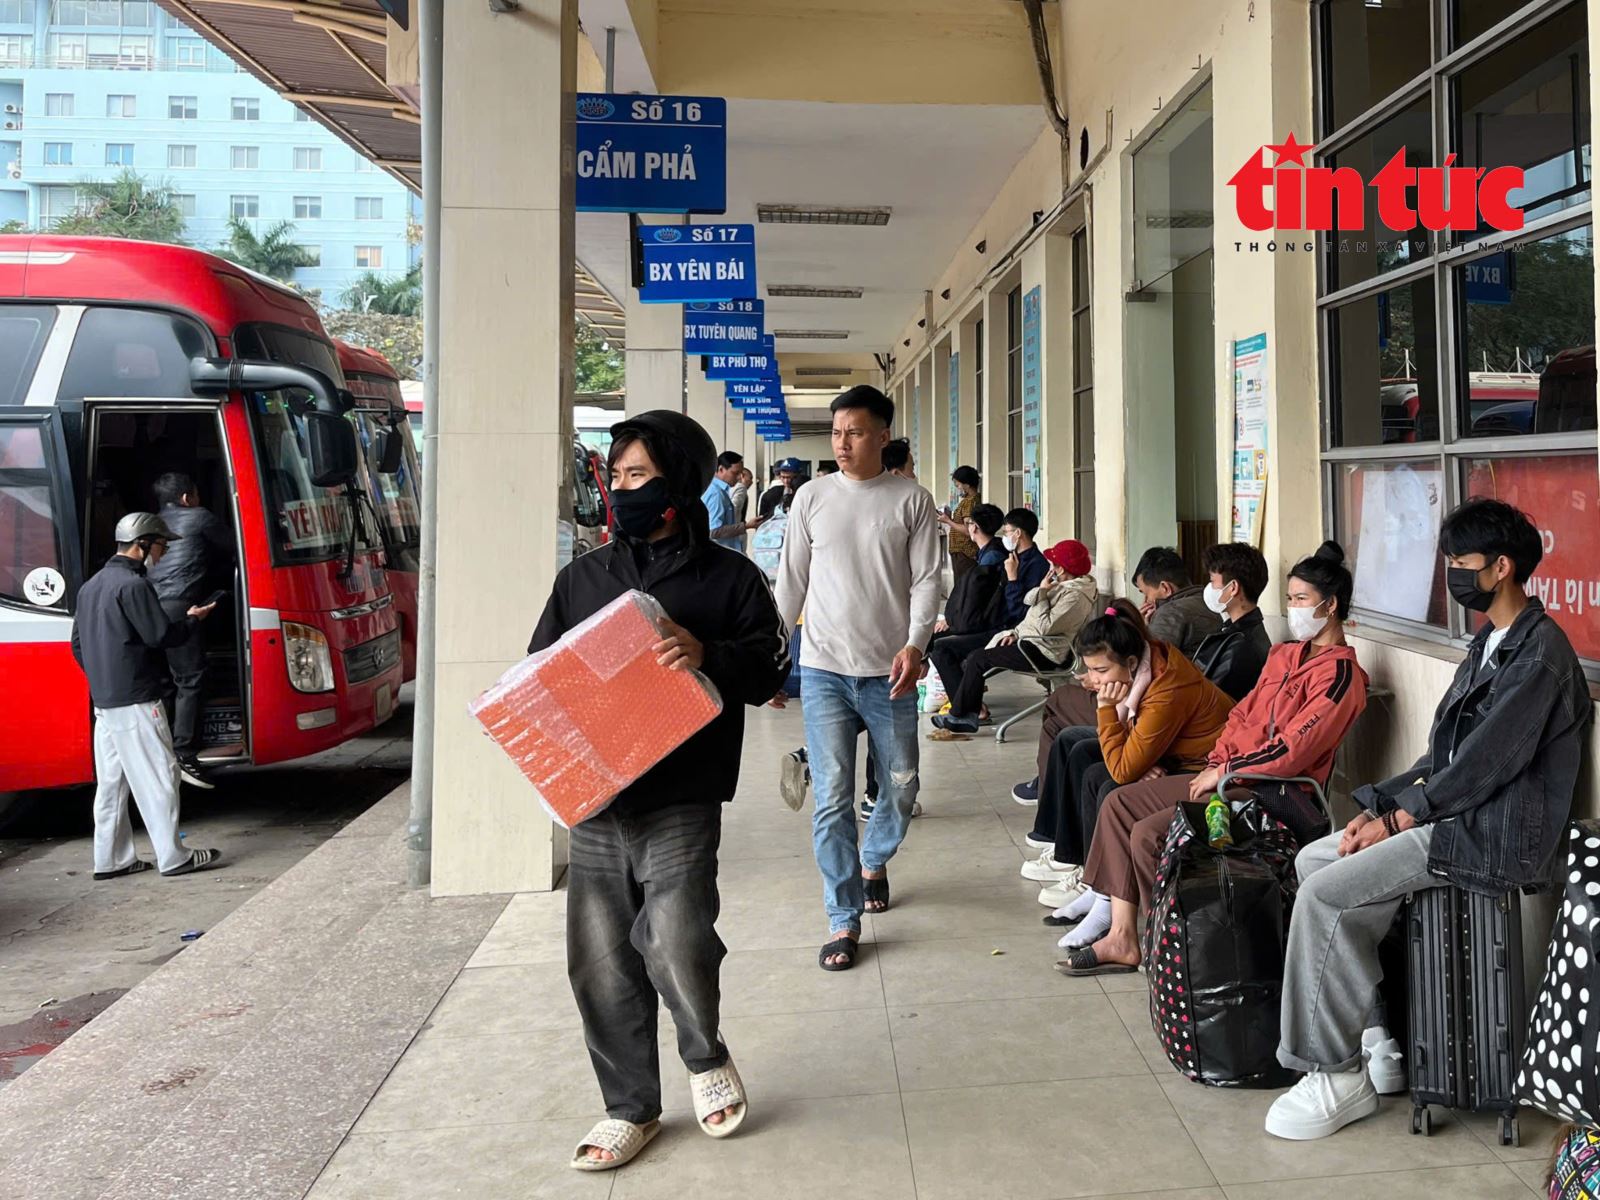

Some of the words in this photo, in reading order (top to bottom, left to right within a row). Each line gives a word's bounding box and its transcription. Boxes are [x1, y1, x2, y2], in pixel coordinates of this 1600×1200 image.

[632, 98, 665, 120] Số
[672, 102, 701, 122] 16
[577, 140, 636, 178] CẨM
[645, 144, 697, 180] PHẢ
[692, 227, 714, 242] Số
[719, 228, 738, 242] 17
[649, 263, 673, 281] BX
[677, 258, 711, 281] YÊN
[716, 258, 745, 280] BÁI
[738, 301, 753, 311] 18
[685, 325, 697, 339] BX
[698, 322, 726, 339] TUYÊN
[728, 326, 758, 341] QUANG
[712, 356, 726, 368] BX
[749, 356, 767, 370] THỌ
[733, 384, 749, 393] YÊN
